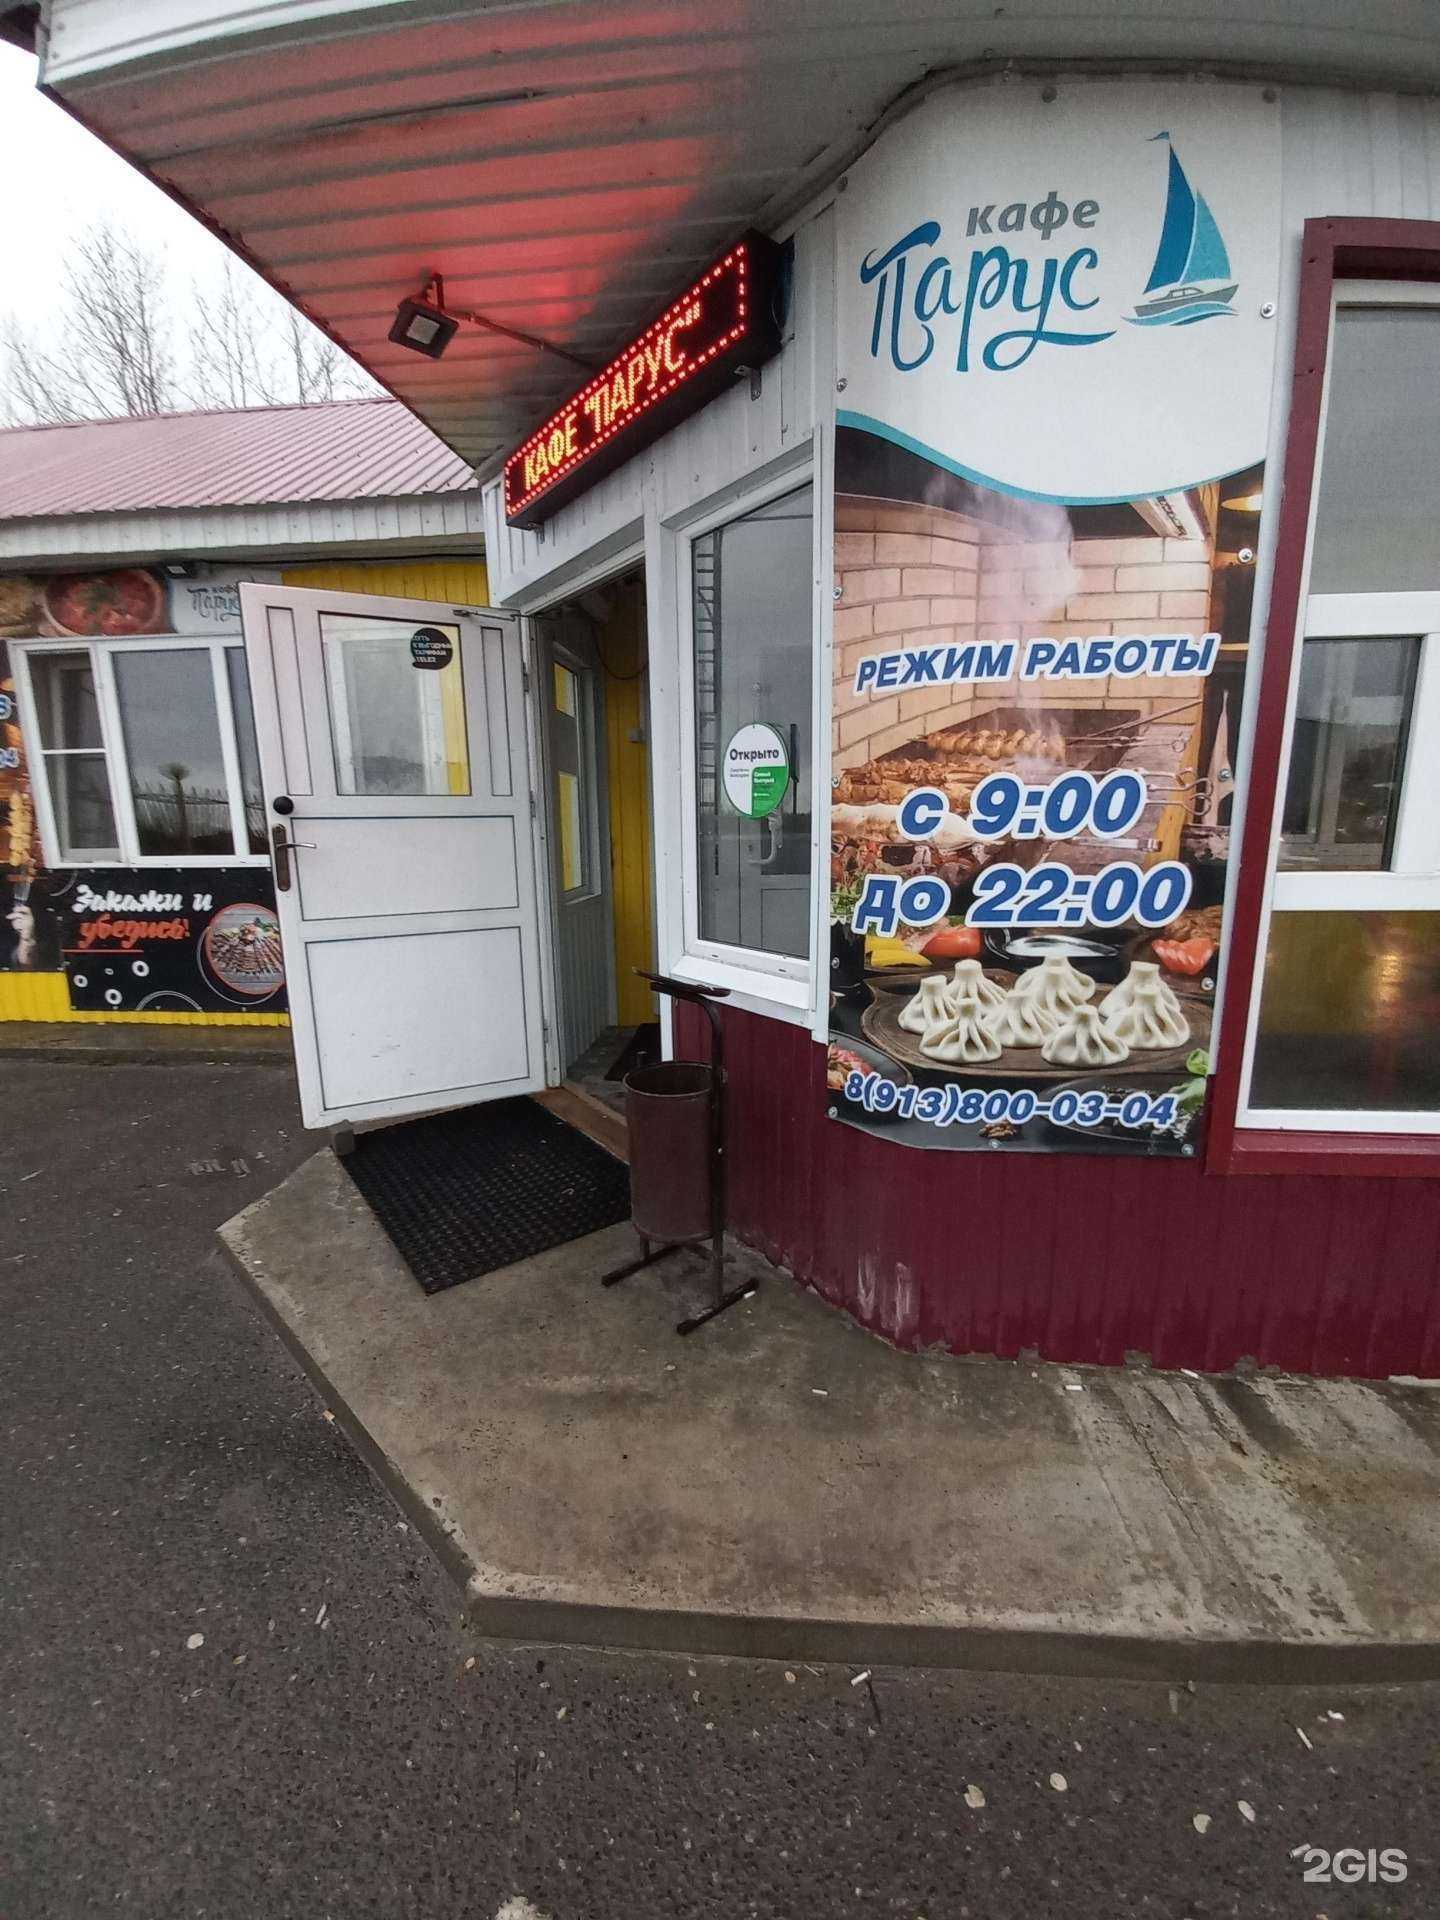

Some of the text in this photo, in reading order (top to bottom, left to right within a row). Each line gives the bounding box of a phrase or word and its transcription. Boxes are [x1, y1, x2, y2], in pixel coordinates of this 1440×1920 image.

[966, 191, 1100, 240] кафе
[860, 221, 1117, 372] Парус
[523, 411, 579, 491] КАФЕ
[856, 636, 1219, 692] РЕЖИМ РАБОТЫ
[729, 748, 780, 762] Открыто
[970, 772, 1144, 838] 9:00
[72, 884, 214, 914] Закажи и
[853, 863, 1190, 935] до 22:00
[78, 913, 191, 950] убедись!
[845, 1072, 1179, 1127] 8(913)800-03-04
